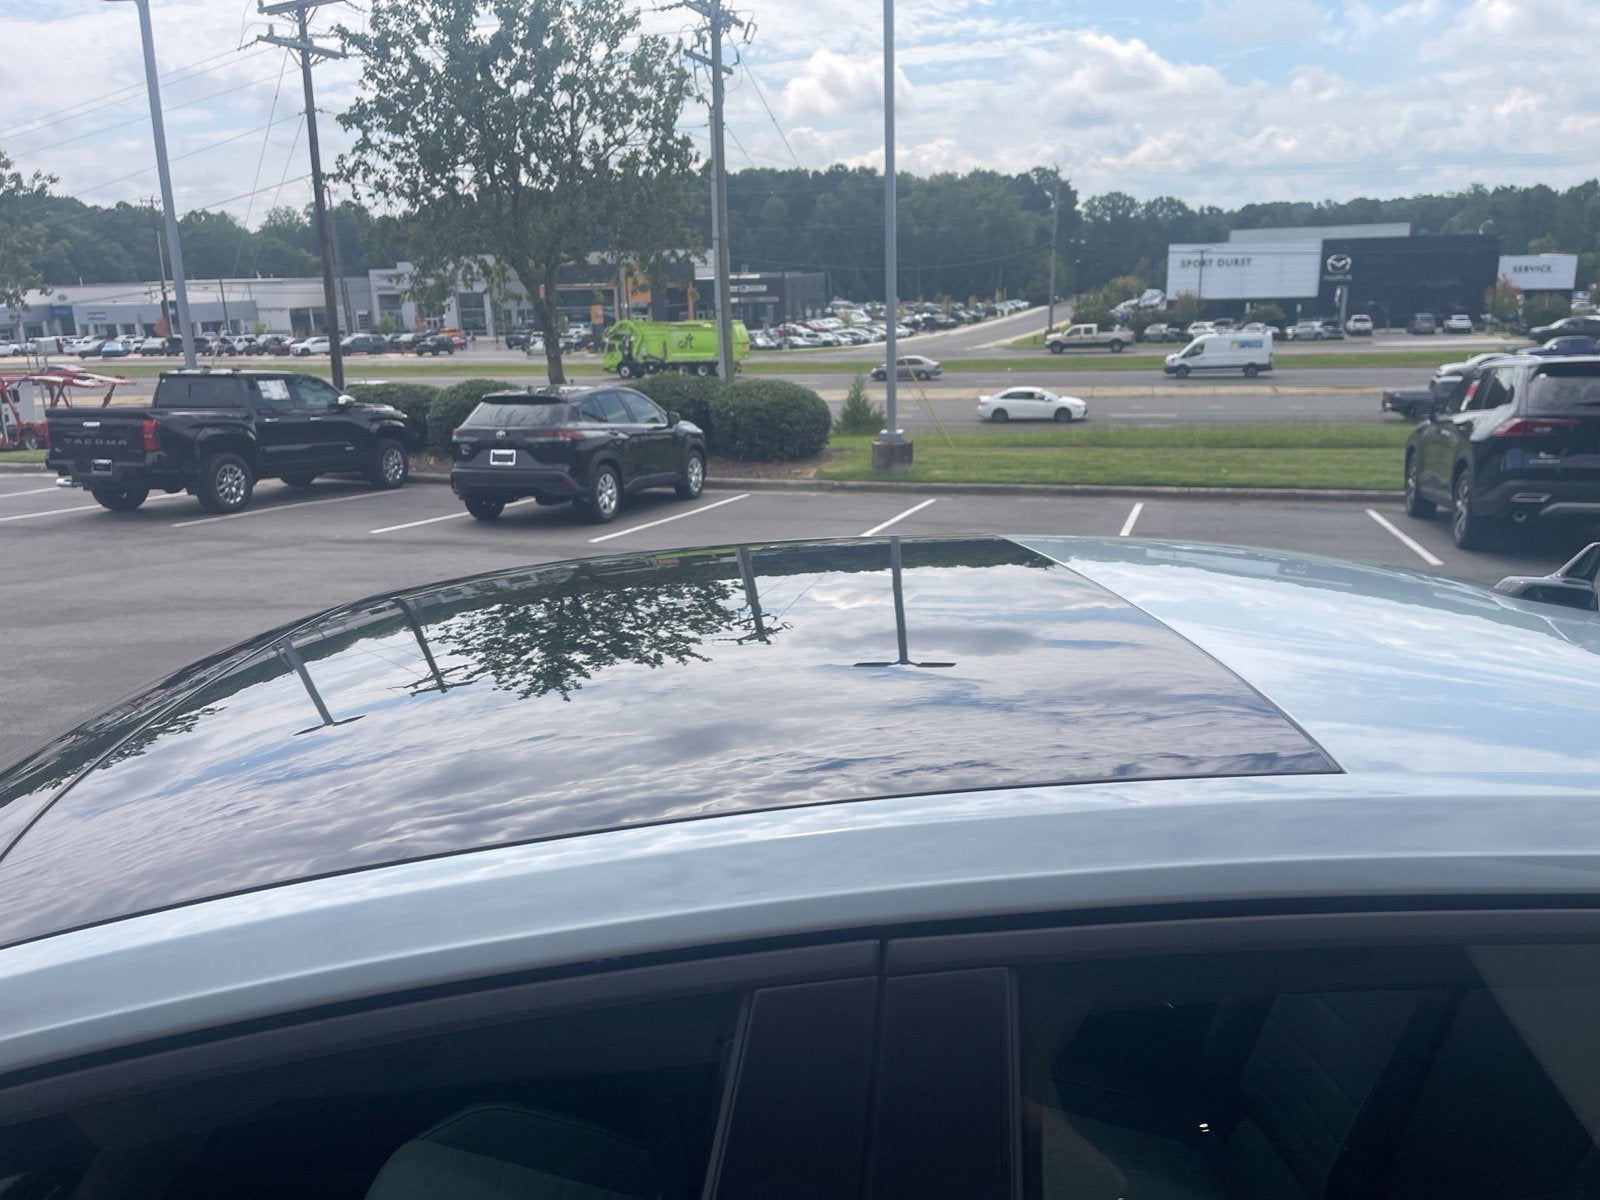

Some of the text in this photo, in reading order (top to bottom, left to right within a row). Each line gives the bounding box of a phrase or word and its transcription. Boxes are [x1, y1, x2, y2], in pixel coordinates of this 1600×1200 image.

[1217, 257, 1252, 267] DURST
[1513, 264, 1552, 273] SERVICE
[63, 438, 127, 446] TACOMA
